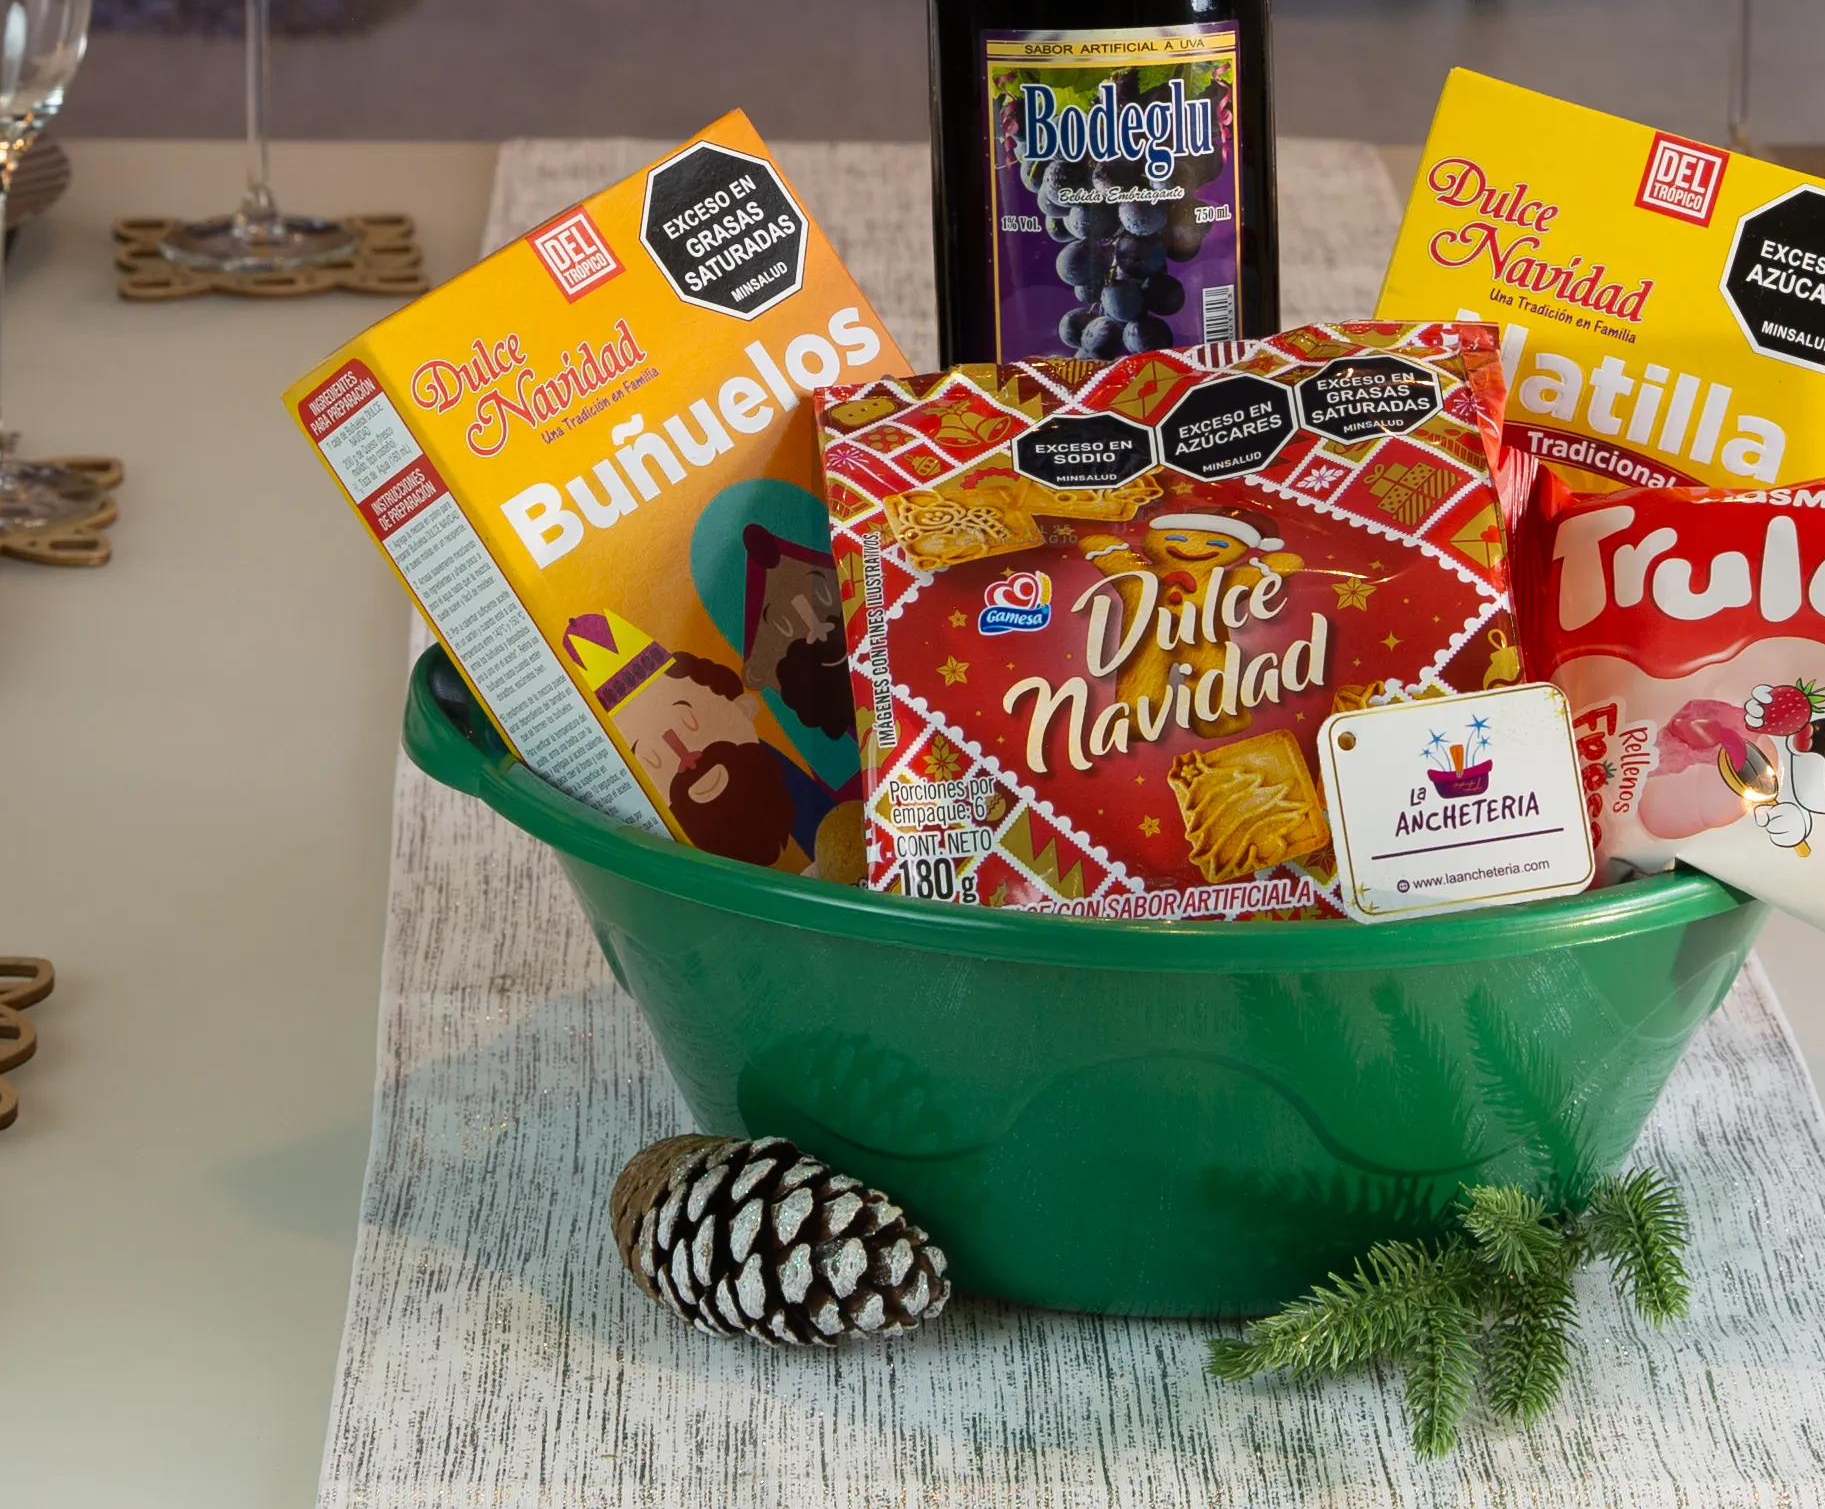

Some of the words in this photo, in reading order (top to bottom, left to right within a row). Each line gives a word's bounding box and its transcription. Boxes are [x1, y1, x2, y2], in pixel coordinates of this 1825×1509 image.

[1024, 44, 1073, 55] SABOR
[1080, 41, 1158, 54] ARTIFICIAL
[1164, 40, 1174, 50] A
[1180, 38, 1205, 49] UVA
[1020, 79, 1214, 181] Bodeglu
[1656, 148, 1708, 194] DEL
[662, 190, 731, 240] EXCESO
[729, 174, 757, 199] EN
[1058, 188, 1102, 203] Bebida
[1105, 187, 1184, 206] Embriagante
[1195, 207, 1214, 223] 750
[1215, 204, 1231, 221] ml.
[1427, 157, 1560, 233] Dulce
[1652, 182, 1704, 211] TRÓPICO
[685, 201, 765, 258] GRASAS
[1002, 216, 1017, 231] 1%
[1019, 216, 1041, 231] Vol.
[544, 225, 597, 272] DEL
[563, 252, 607, 286] TRÓPICO
[684, 214, 796, 292] SATURADAS
[730, 261, 788, 302] MINSALUD
[1429, 221, 1655, 324] Navidad
[1490, 288, 1513, 306] Una
[1518, 295, 1573, 325] Tradición
[1575, 317, 1591, 329] en
[1594, 320, 1636, 344] Familia
[307, 369, 359, 417] INGREDIENTES
[411, 332, 528, 415] Dulce
[466, 317, 648, 458] Navidad
[1316, 374, 1388, 391] EXCESO
[1391, 372, 1415, 384] EN
[1325, 384, 1411, 405] GRASAS
[309, 413, 332, 436] PARA
[324, 374, 376, 423] PREPARACIÓN
[561, 397, 611, 432] Tradición
[611, 389, 625, 403] en
[622, 366, 660, 395] Familia
[1178, 407, 1245, 439] EXCESO
[1248, 400, 1273, 419] EN
[1311, 397, 1431, 424] SATURADAS
[500, 306, 880, 570] Buñuelos
[1035, 441, 1104, 454] EXCESO
[1109, 440, 1133, 451] EN
[1175, 414, 1282, 457] AZÚCARES
[1343, 418, 1405, 434] MINSALUD
[1053, 452, 1116, 465] SODIO
[1056, 473, 1117, 482] MINSALUD
[1202, 451, 1262, 472] MINSALUD
[1527, 431, 1676, 488] Tradicional
[370, 467, 426, 516] INSTRUCCIONES
[384, 476, 437, 524] PREPARACIÓN
[377, 513, 392, 531] DE
[868, 608, 887, 645] FINES
[986, 610, 1043, 625] Gamesa
[1070, 566, 1289, 679] Dulce
[871, 646, 888, 676] CON
[873, 678, 896, 748] IMÁGENES
[1002, 611, 1328, 774] Navidad
[890, 779, 965, 802] Porciones
[970, 777, 995, 801] por
[1613, 727, 1650, 813] Rellenos
[893, 803, 971, 826] empaque:
[975, 796, 985, 819] 6
[1395, 791, 1540, 837] ANCHETERIA
[1410, 786, 1426, 806] La
[897, 834, 943, 857] CONT.
[947, 829, 992, 854] NETO
[898, 858, 954, 900] 180
[961, 875, 977, 903] g
[1413, 859, 1550, 889] www.laancheteria.com
[1107, 894, 1179, 919] SABOR
[1182, 881, 1294, 912] ARTIFICIAL
[1297, 877, 1315, 904] A
